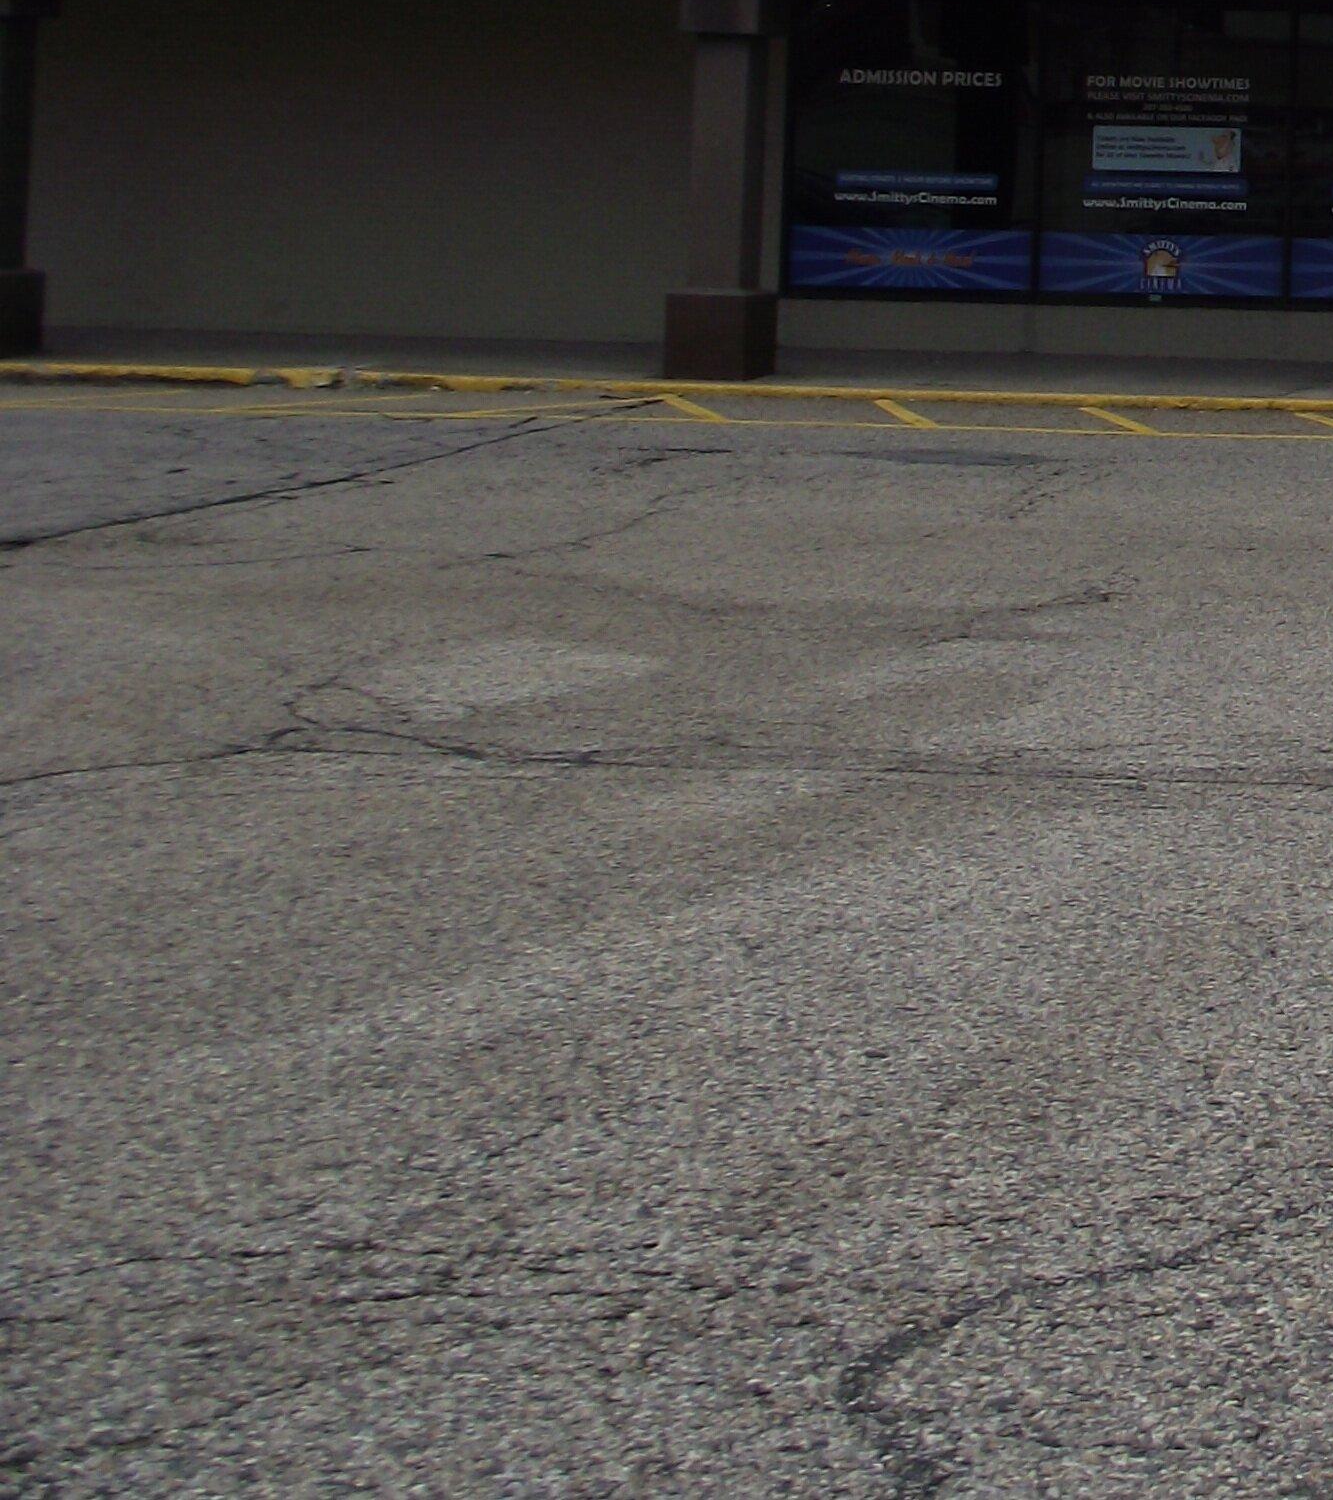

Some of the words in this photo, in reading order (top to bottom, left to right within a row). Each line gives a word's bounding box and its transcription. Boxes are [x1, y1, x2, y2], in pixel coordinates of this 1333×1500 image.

[840, 68, 938, 86] ADMISSION
[942, 70, 1003, 88] PRICES
[1086, 75, 1115, 88] FOR
[1119, 76, 1165, 89] MOVIE
[1168, 77, 1250, 90] SHOWTIMES
[834, 190, 997, 205] www.SmittysCinema.com
[1083, 196, 1247, 211] www.SmittysCinema.com
